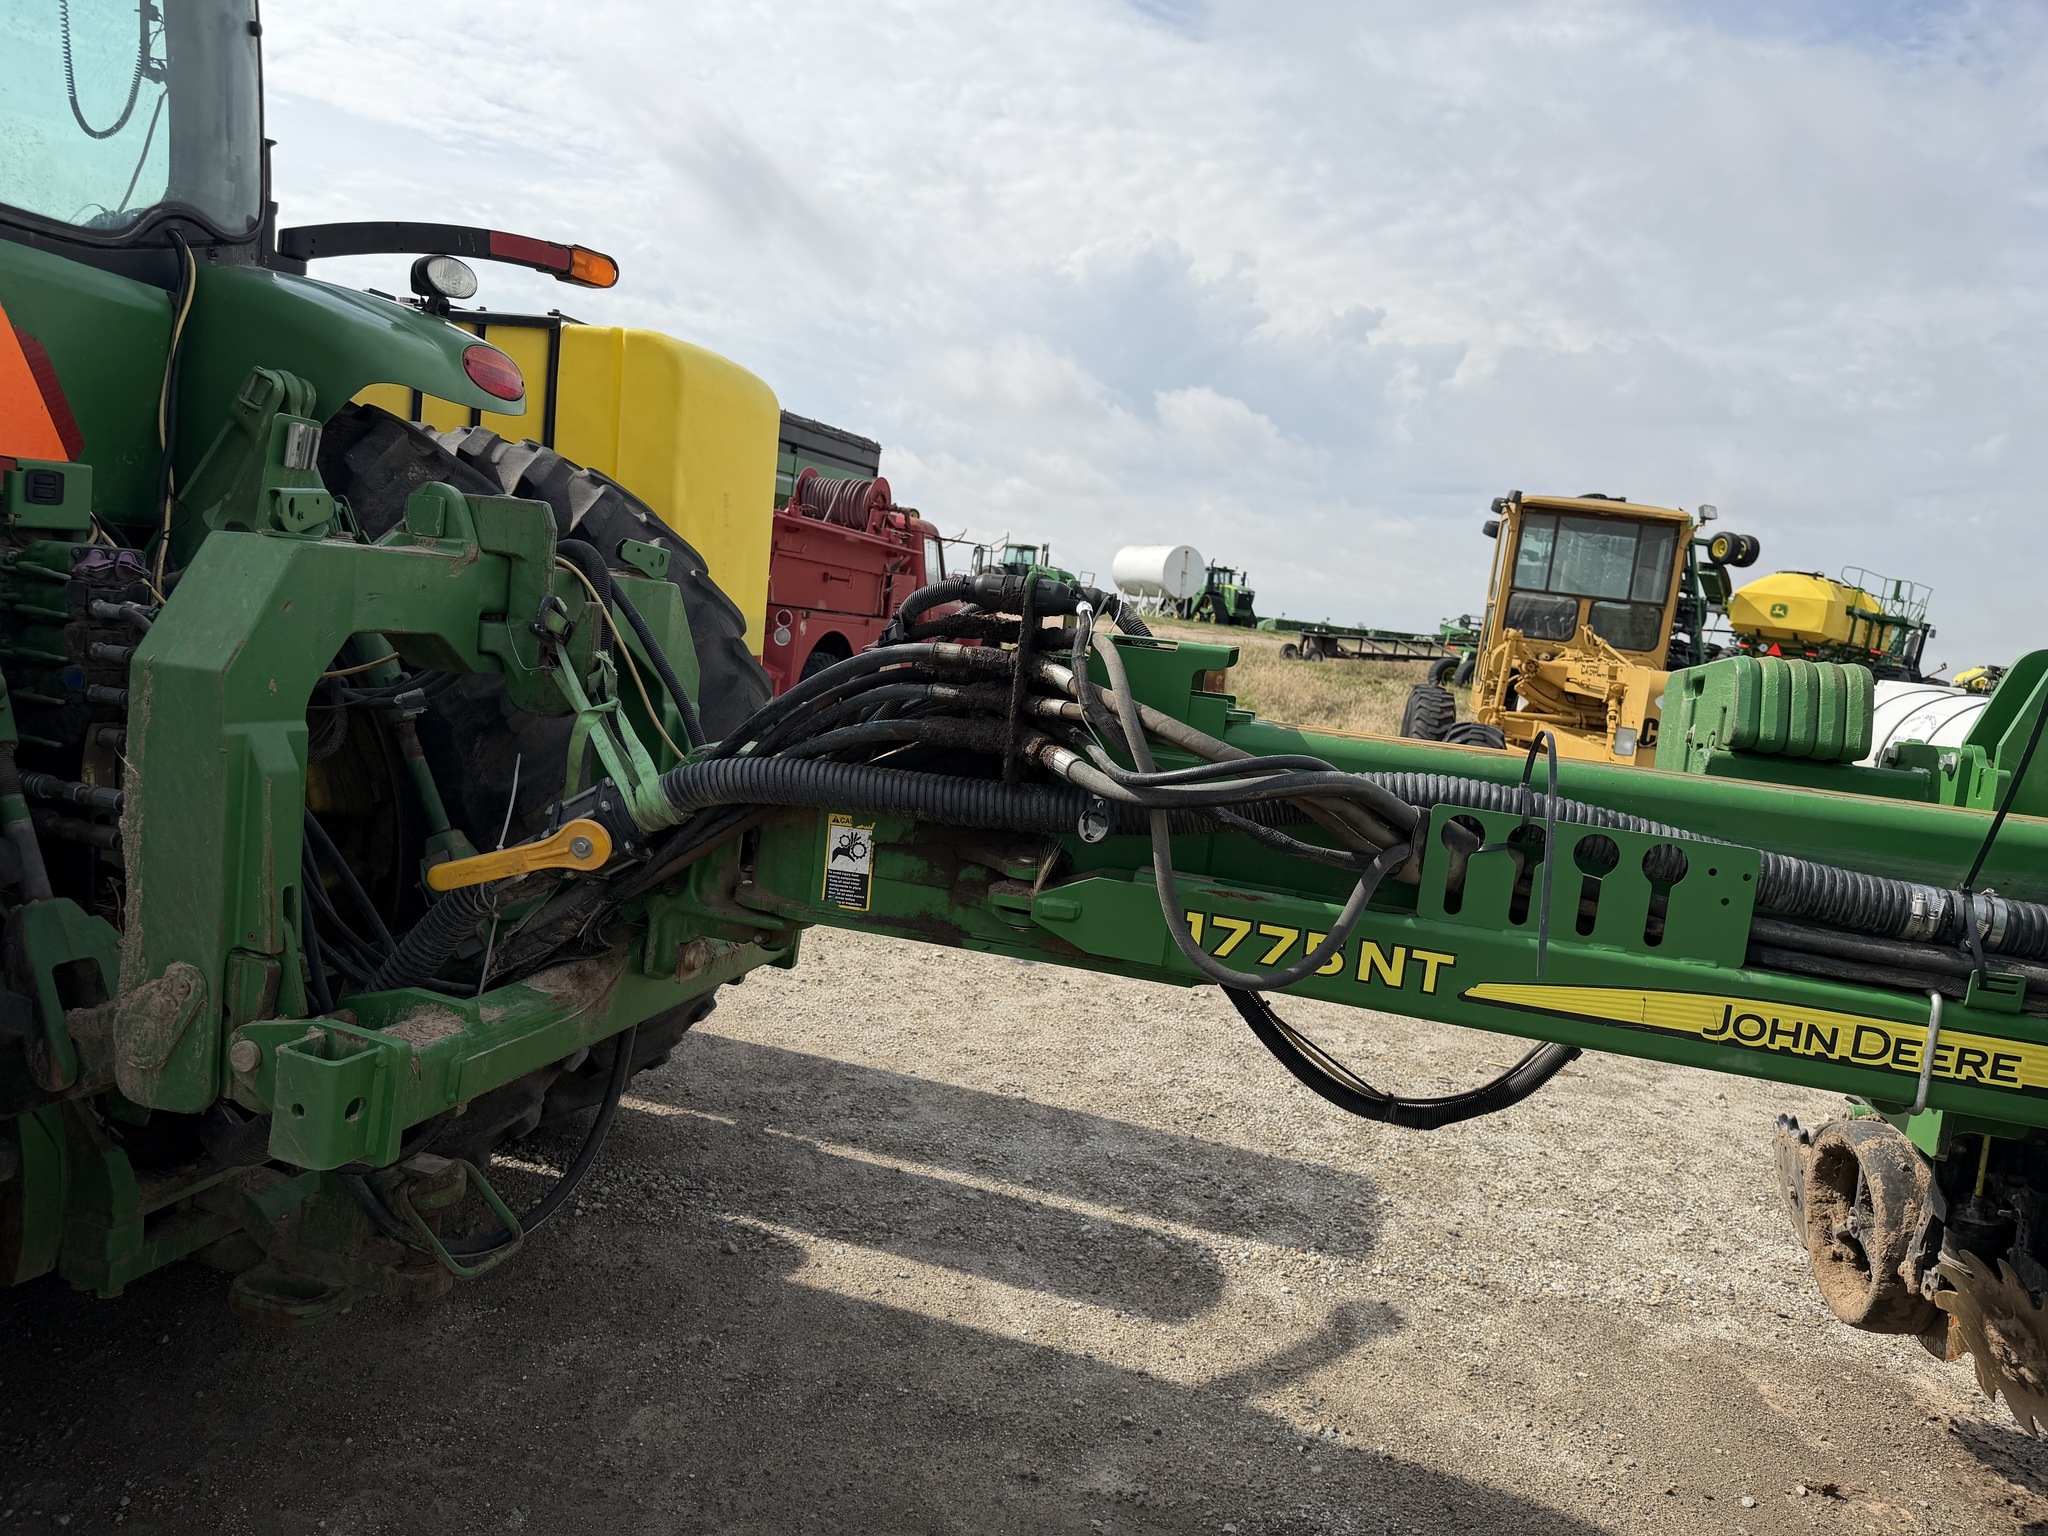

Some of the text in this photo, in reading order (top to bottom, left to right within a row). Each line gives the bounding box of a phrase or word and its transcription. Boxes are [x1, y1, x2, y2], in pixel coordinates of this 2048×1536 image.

[1184, 911, 1457, 995] 1775 NT
[1701, 1004, 2023, 1083] JOHN DEERE
